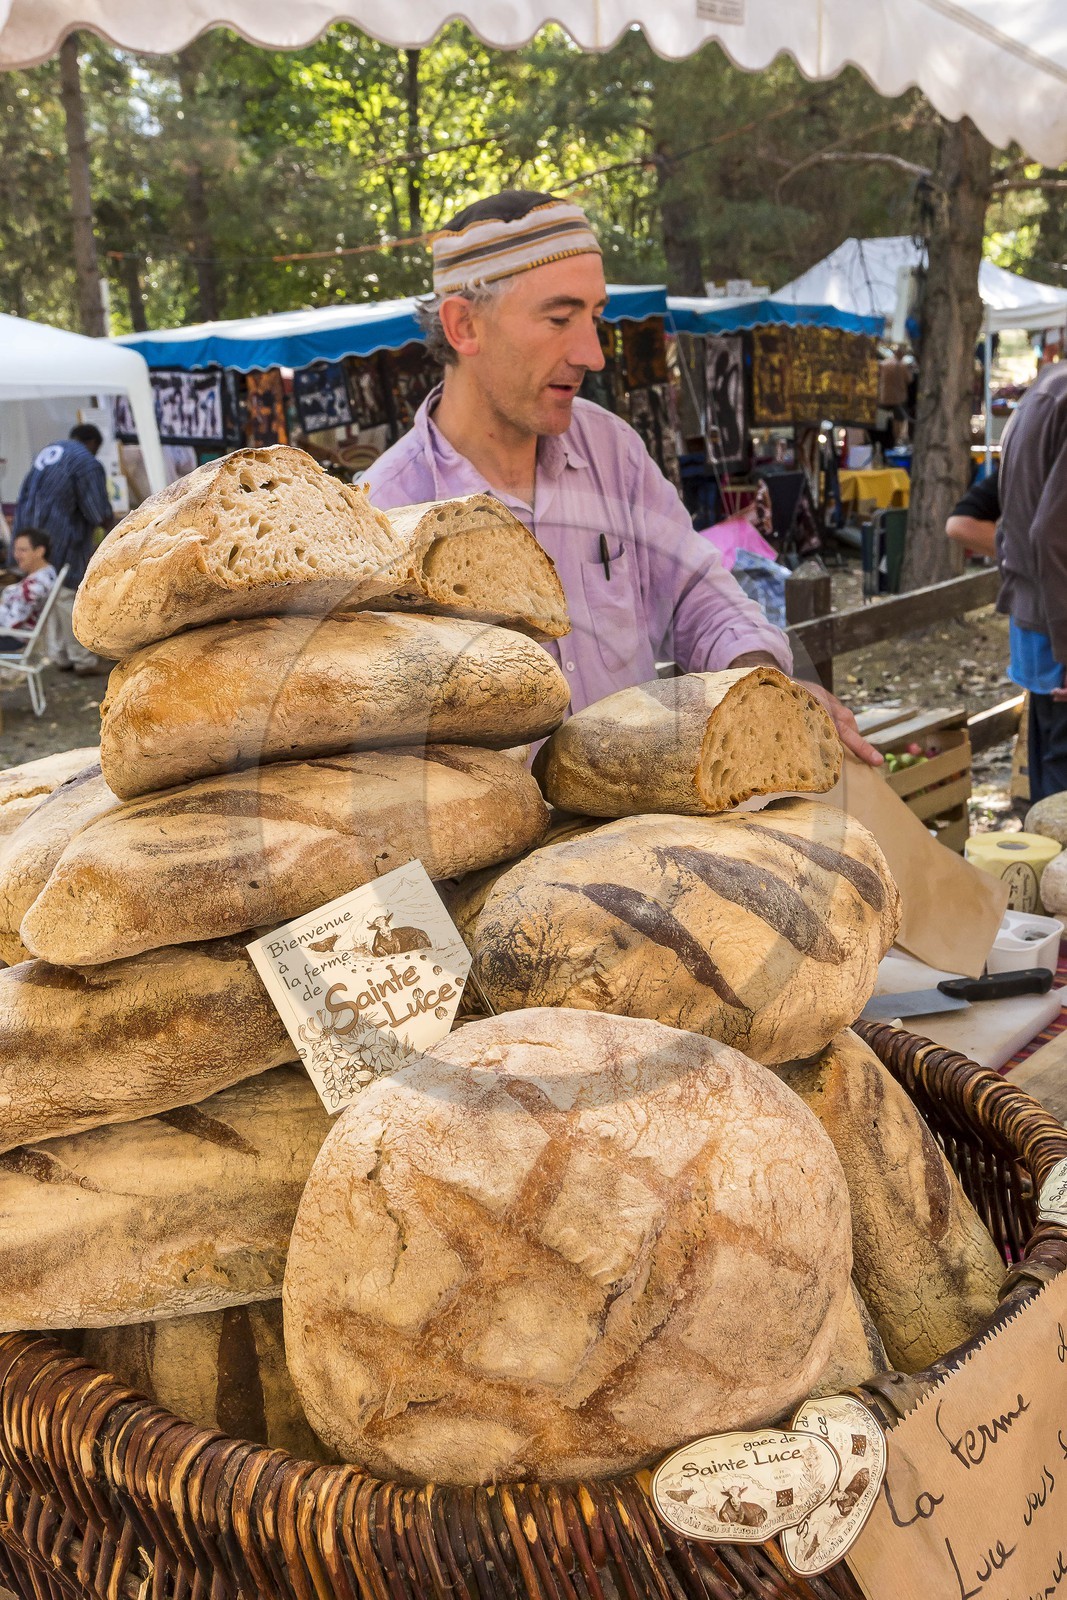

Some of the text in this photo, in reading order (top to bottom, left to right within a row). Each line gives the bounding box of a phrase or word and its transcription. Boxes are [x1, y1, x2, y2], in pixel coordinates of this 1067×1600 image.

[267, 910, 354, 959] Bienvenue
[278, 961, 290, 975] à
[282, 950, 352, 990] la ferme
[302, 984, 324, 1002] de
[324, 964, 421, 1036] Sainte
[374, 981, 458, 1029] Luce
[743, 1433, 798, 1452] gaec de
[818, 1416, 830, 1439] ce
[681, 1449, 803, 1479] Sainte Luce
